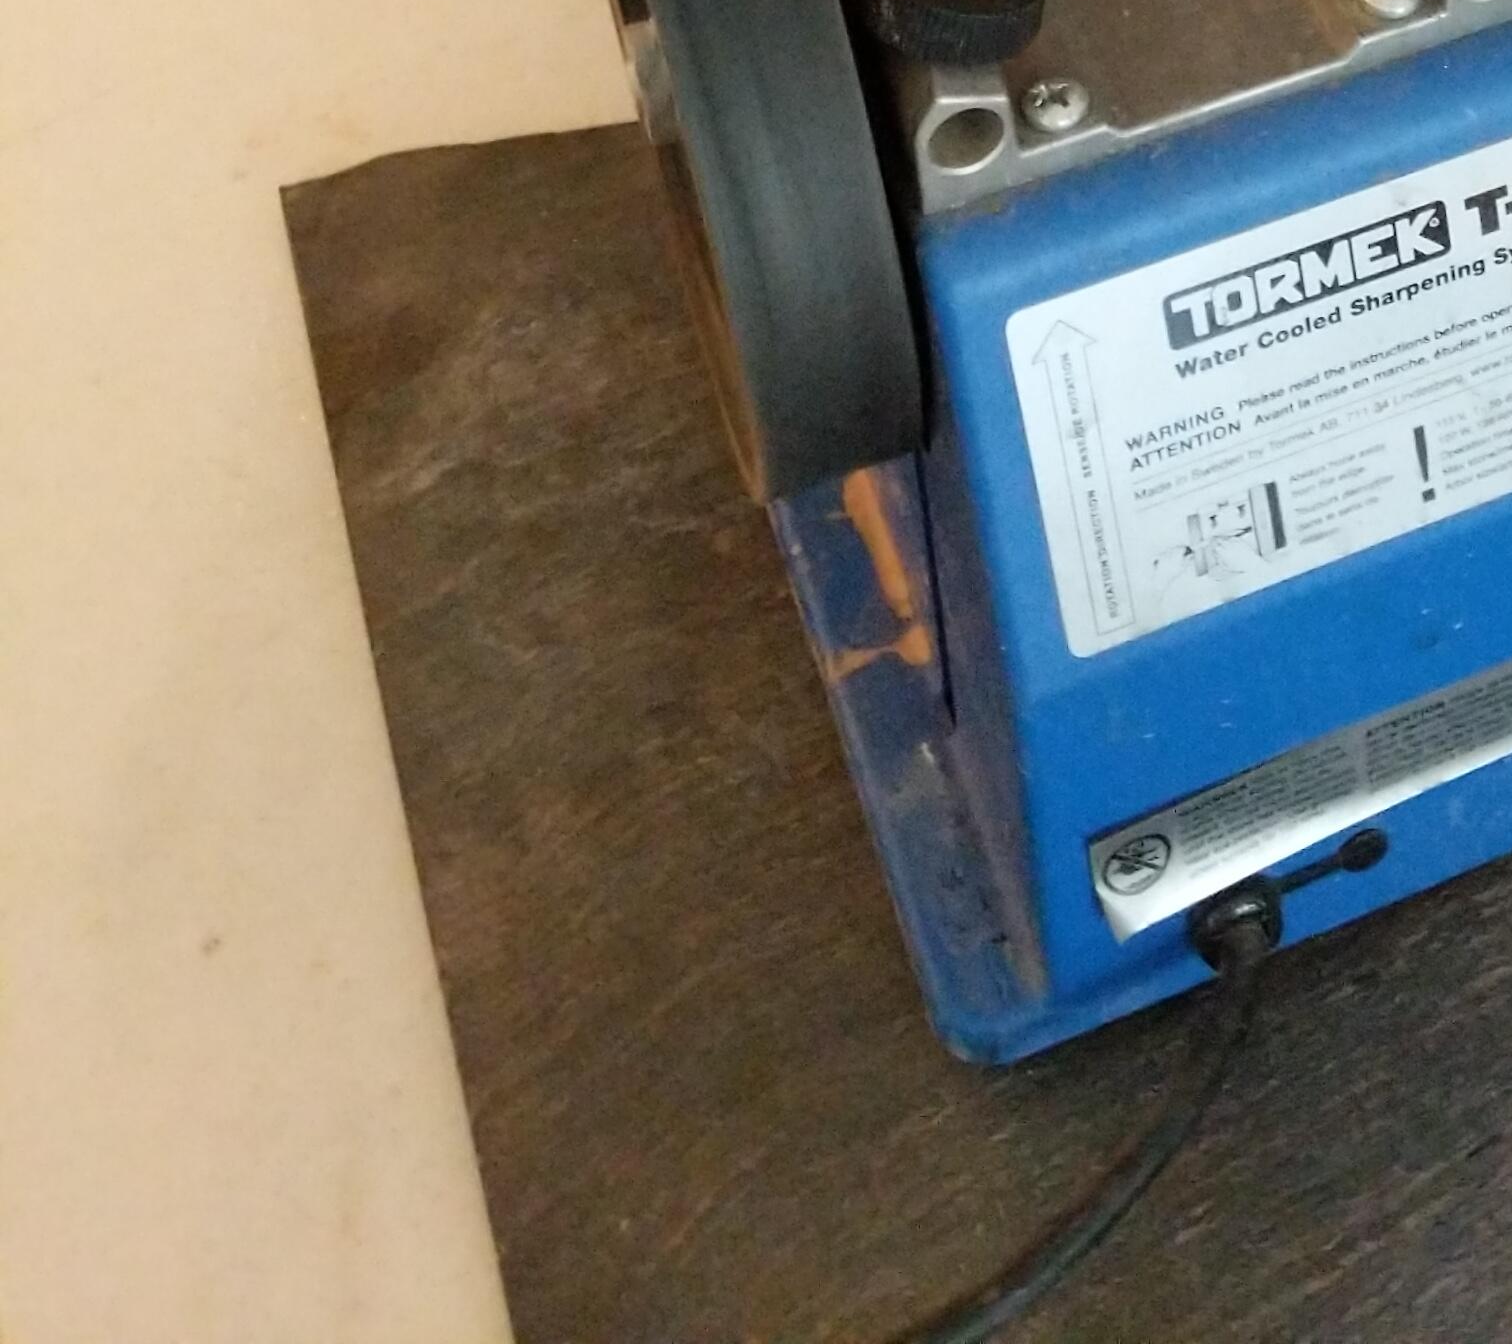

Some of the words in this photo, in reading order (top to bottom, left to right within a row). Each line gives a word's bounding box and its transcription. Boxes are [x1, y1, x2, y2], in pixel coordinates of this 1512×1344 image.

[1167, 203, 1448, 347] TORMEK
[1174, 339, 1248, 380] Water
[1257, 305, 1341, 351] Cooled
[1349, 254, 1485, 318] Sharpening
[1124, 405, 1225, 453] WARNING
[1238, 385, 1285, 412] Please
[1289, 372, 1319, 393] read
[1323, 363, 1345, 381] the
[1349, 332, 1429, 371] instructions
[1433, 315, 1477, 341] before
[1128, 419, 1241, 472] ATTENTION
[1253, 402, 1294, 426] Avant
[1298, 396, 1310, 410] la
[1314, 382, 1348, 404] mise
[1352, 376, 1369, 390] en
